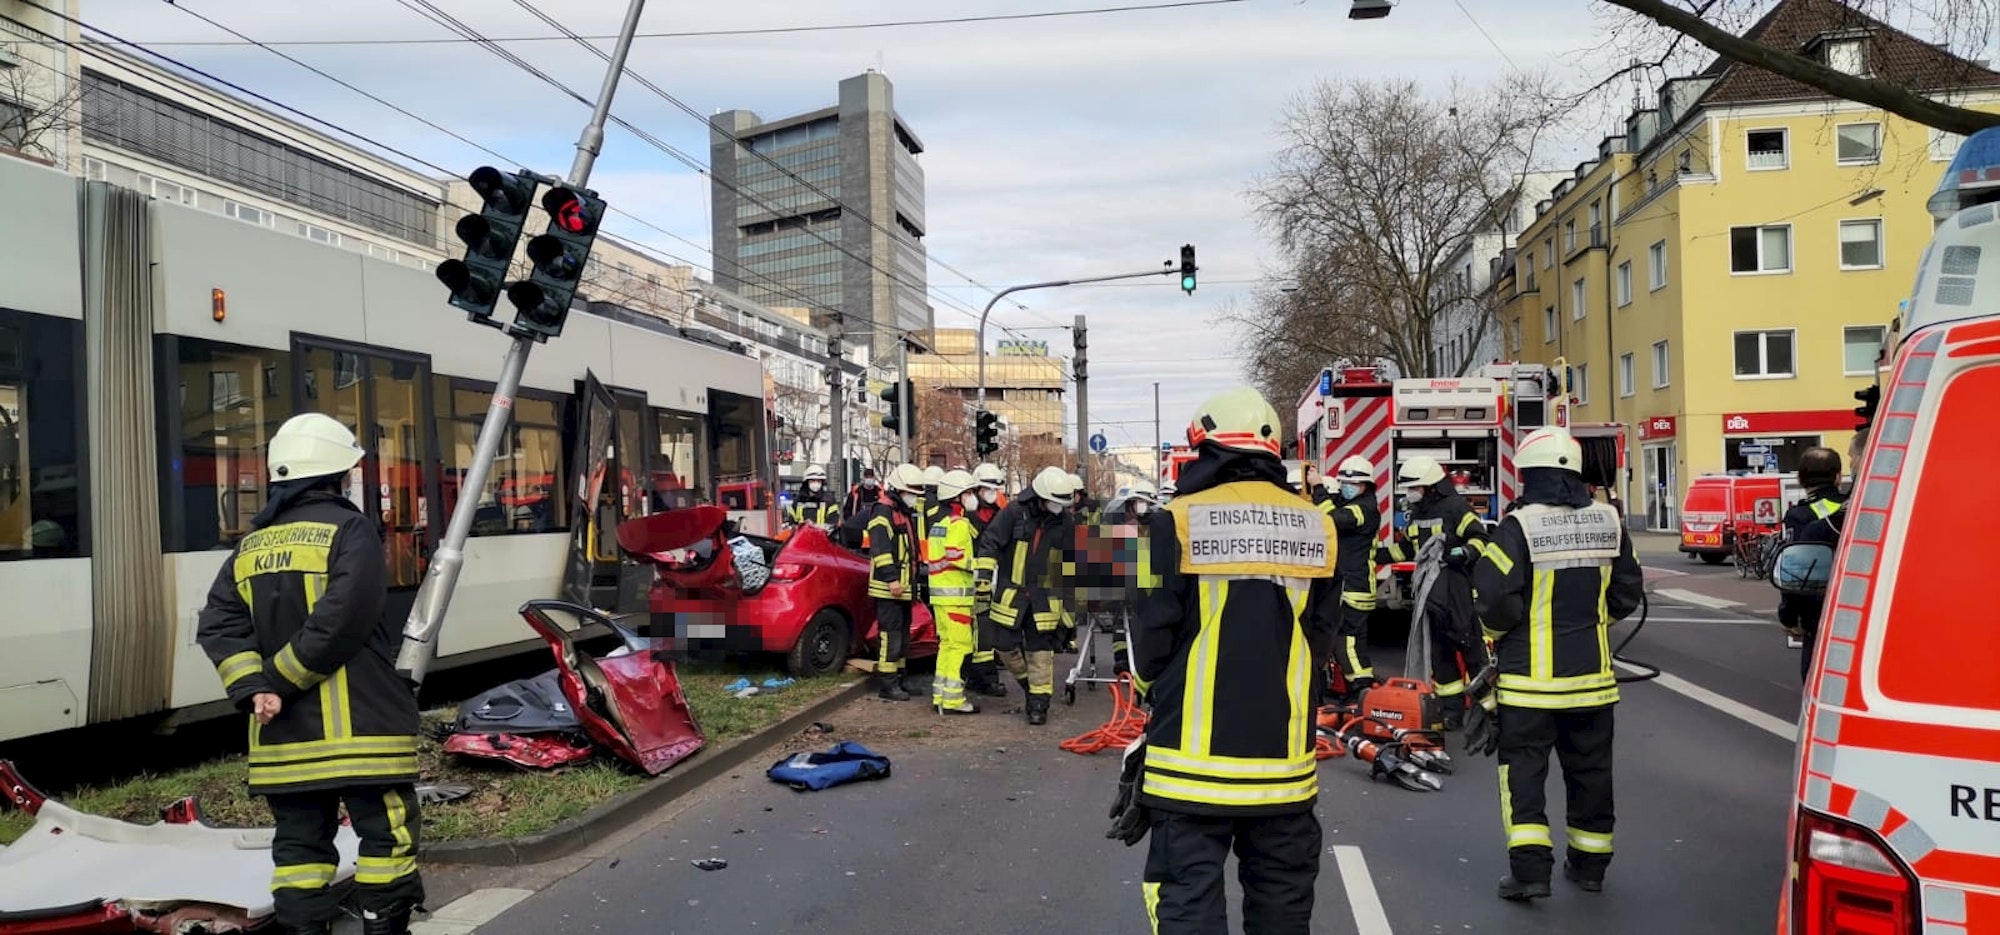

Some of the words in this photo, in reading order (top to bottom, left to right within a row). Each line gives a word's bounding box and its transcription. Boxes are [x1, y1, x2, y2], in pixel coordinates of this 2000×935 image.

[1653, 419, 1671, 429] DER
[1727, 416, 1749, 430] DER
[1209, 509, 1307, 529] EINSATZLEITER
[1541, 513, 1604, 527] EINSATZLEITER
[1532, 532, 1617, 548] BERUFSFEUERWEHR
[1191, 538, 1325, 559] BERUFSFEUERWEHR
